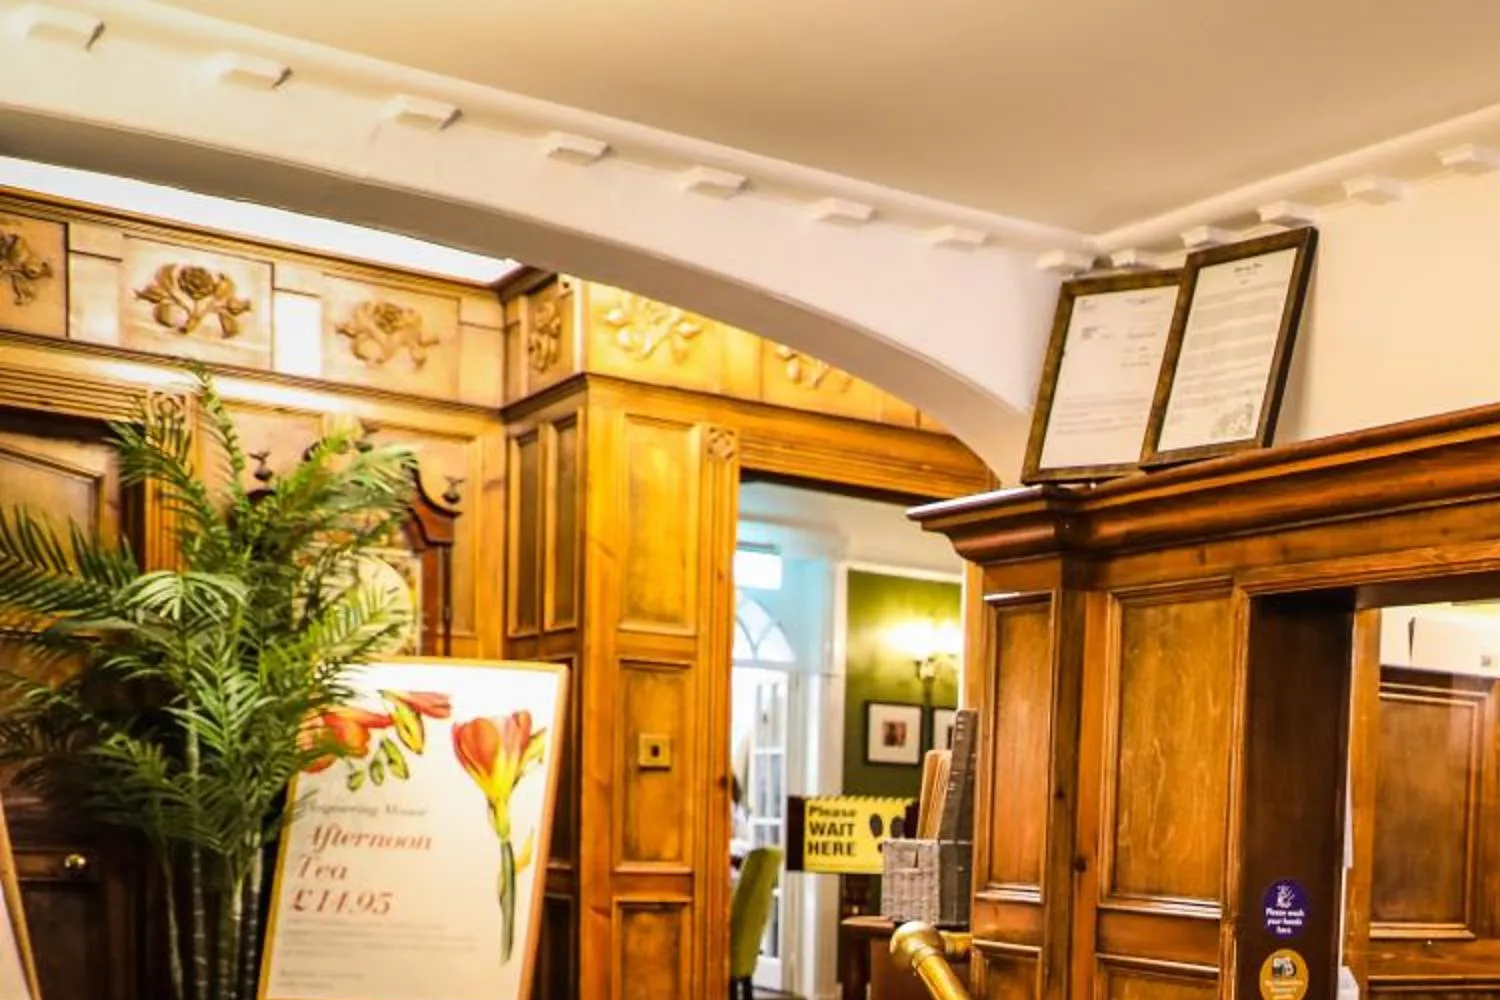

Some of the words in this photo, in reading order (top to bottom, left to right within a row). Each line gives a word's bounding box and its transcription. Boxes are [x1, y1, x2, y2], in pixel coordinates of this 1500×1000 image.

[808, 805, 857, 818] Please
[808, 822, 856, 836] WAIT
[308, 822, 434, 855] Afternoon
[807, 841, 857, 856] HERE
[297, 853, 349, 881] Tea
